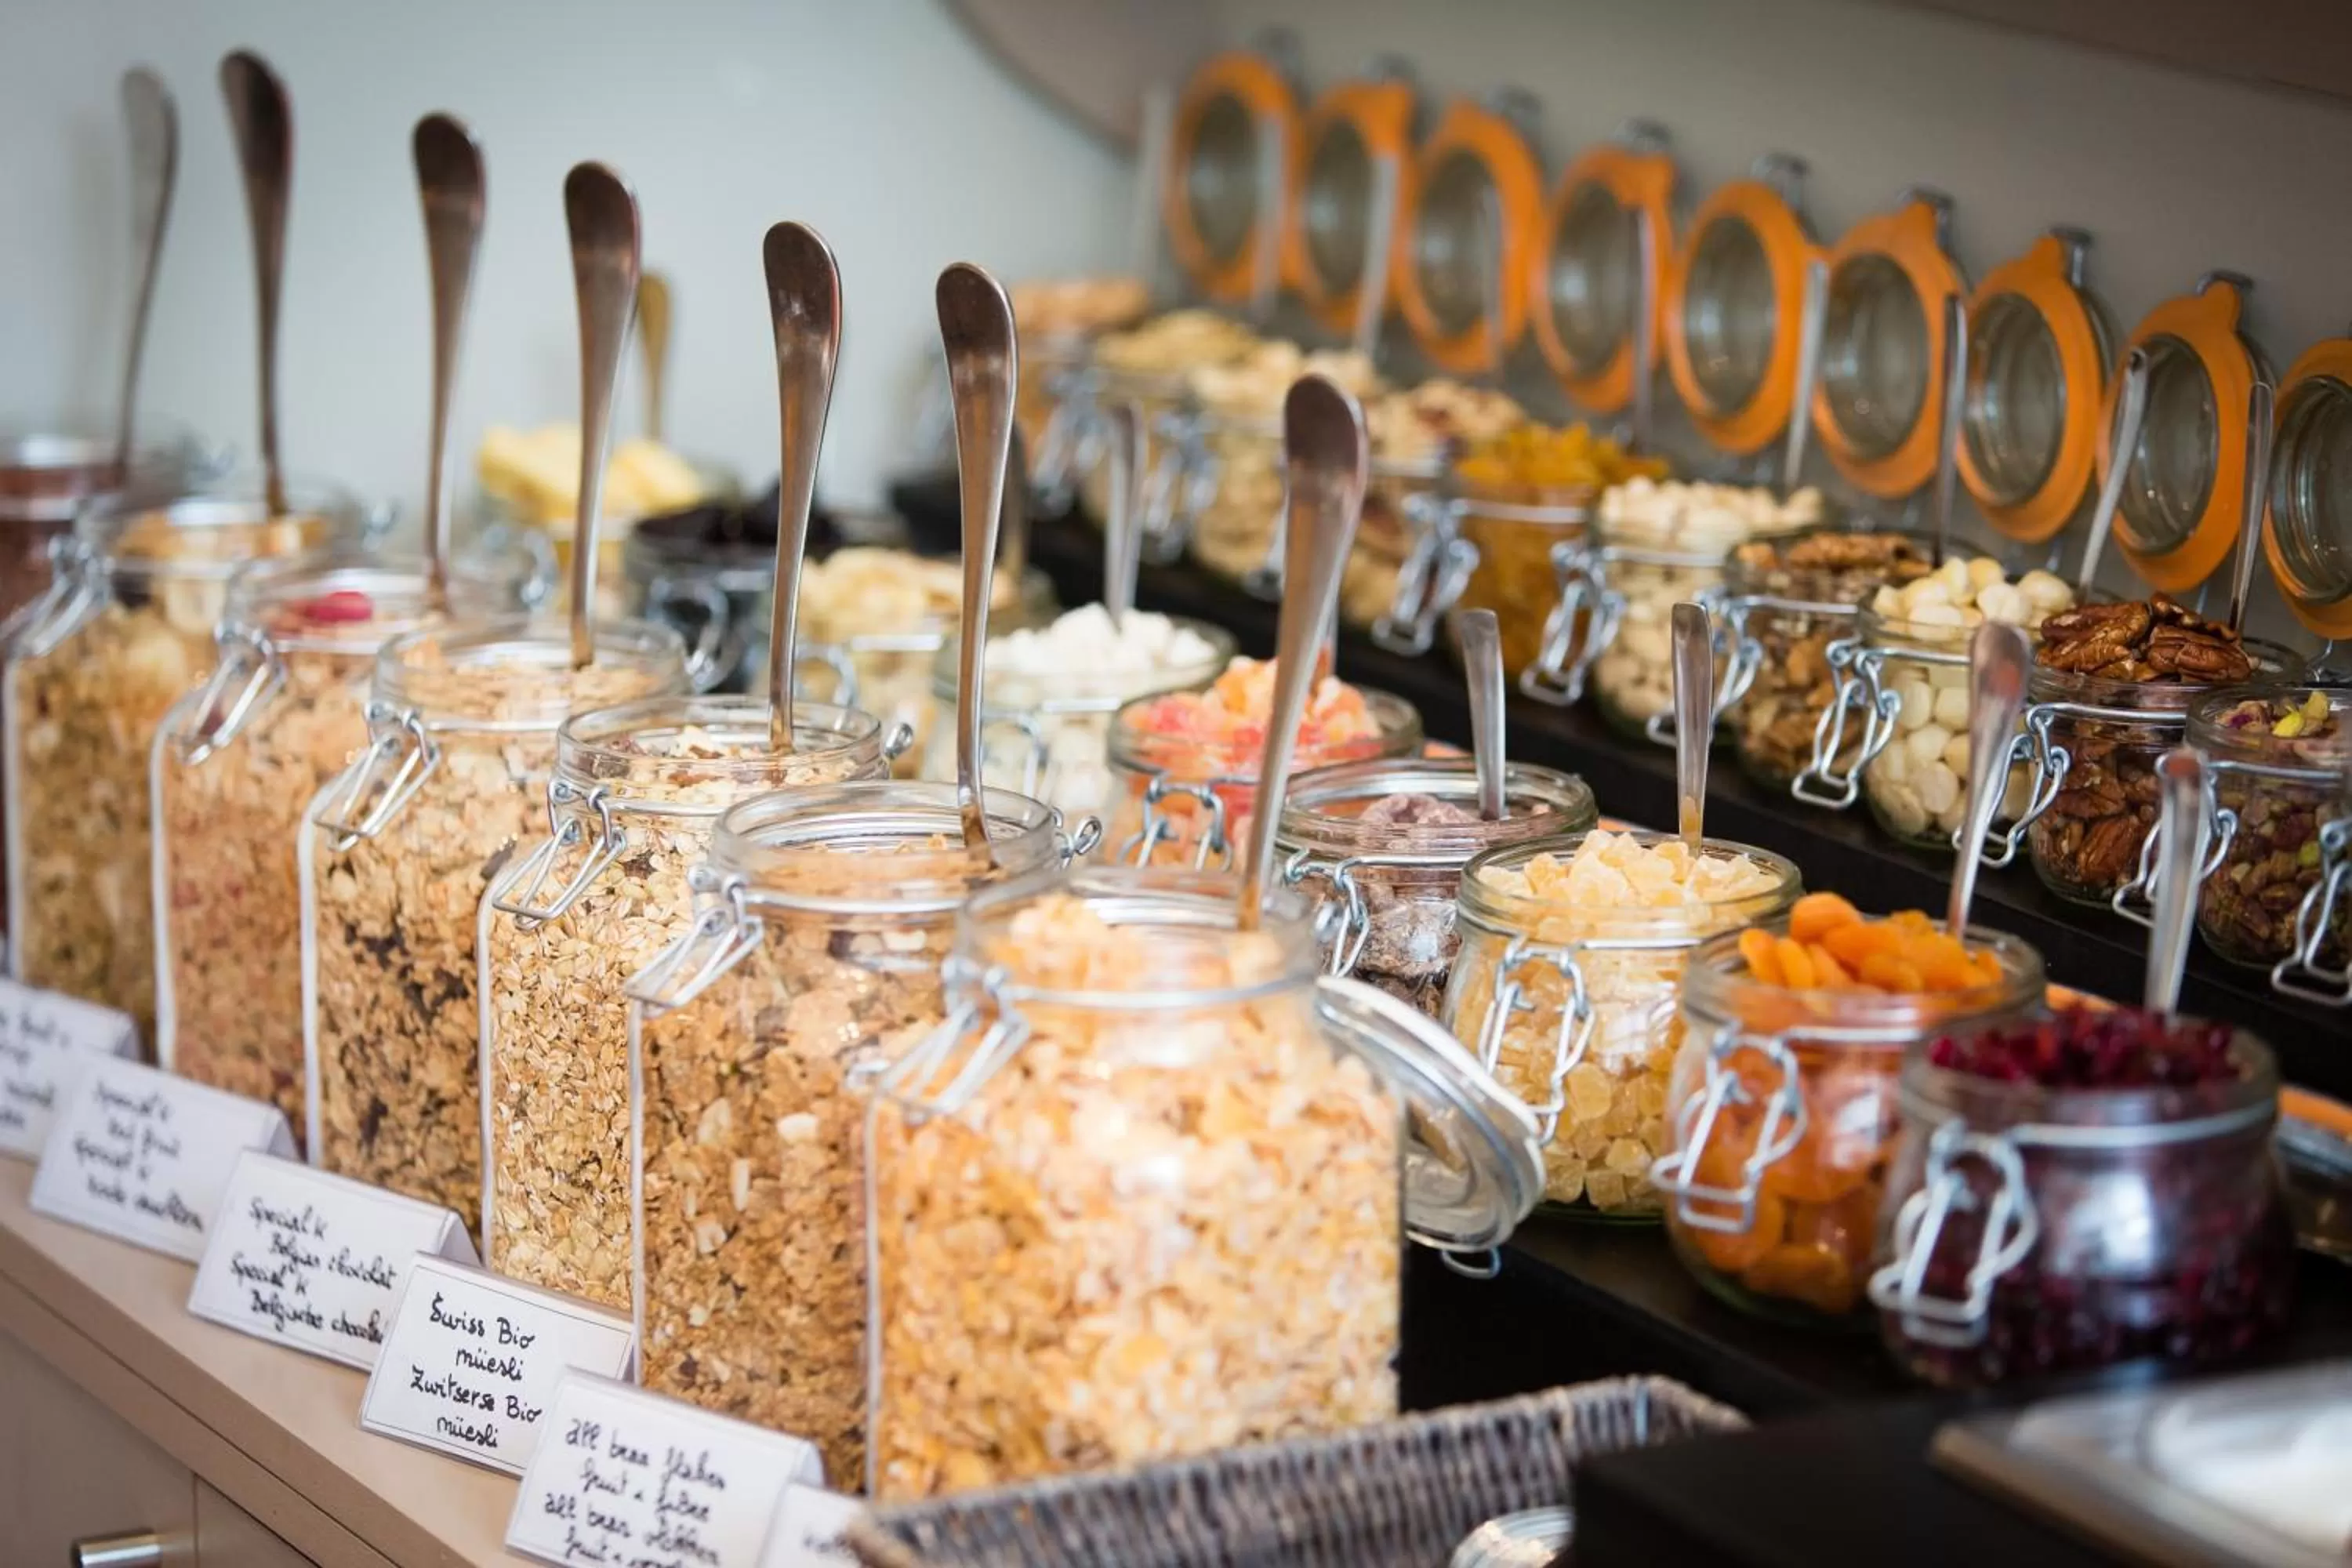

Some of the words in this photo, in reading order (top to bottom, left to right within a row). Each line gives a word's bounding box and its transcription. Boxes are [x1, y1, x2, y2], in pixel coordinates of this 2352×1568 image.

[430, 1292, 485, 1338] Swiss
[496, 1316, 535, 1348] Bio
[456, 1347, 524, 1381] müesli
[410, 1364, 495, 1411] Zwitserse
[506, 1395, 543, 1422] Bio
[437, 1417, 499, 1448] müesli
